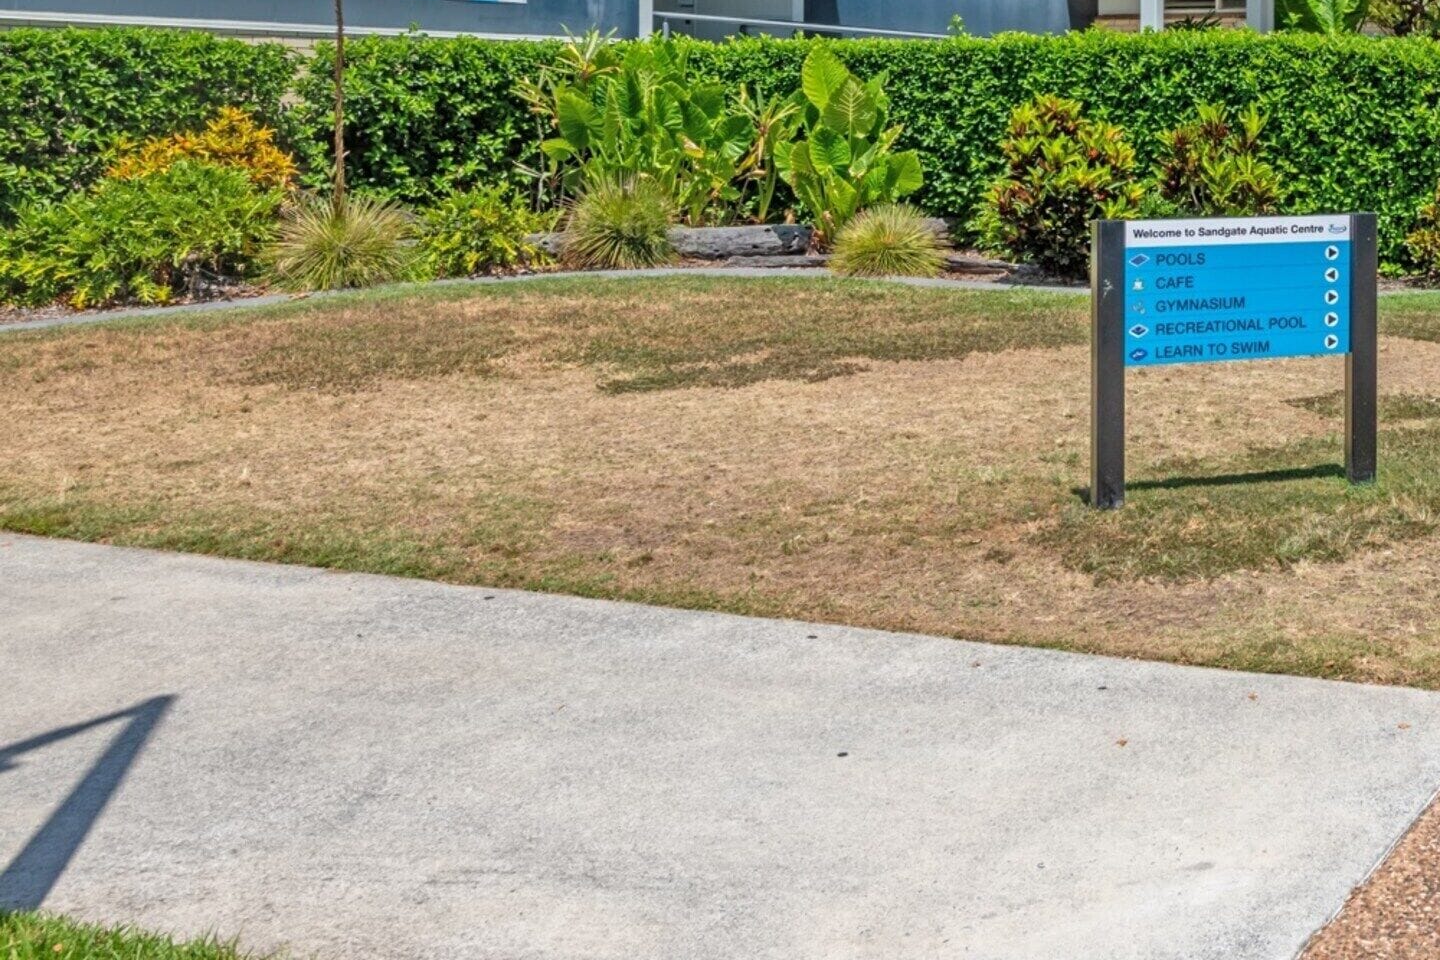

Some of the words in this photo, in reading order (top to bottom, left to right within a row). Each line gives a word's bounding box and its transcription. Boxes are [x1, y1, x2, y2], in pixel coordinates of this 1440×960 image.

[1133, 229, 1182, 238] Welcome
[1185, 228, 1195, 237] to
[1198, 227, 1247, 238] Sandgate
[1249, 224, 1288, 236] Aquatic
[1290, 223, 1324, 234] Centre
[1156, 253, 1206, 266] POOLS
[1155, 276, 1194, 289] CAFE
[1155, 296, 1246, 312] GYMNASIUM
[1155, 319, 1264, 335] RECREATIONAL
[1268, 316, 1307, 330] POOL
[1155, 345, 1203, 359] LEARN
[1207, 343, 1227, 356] TO
[1231, 341, 1270, 355] SWIM
